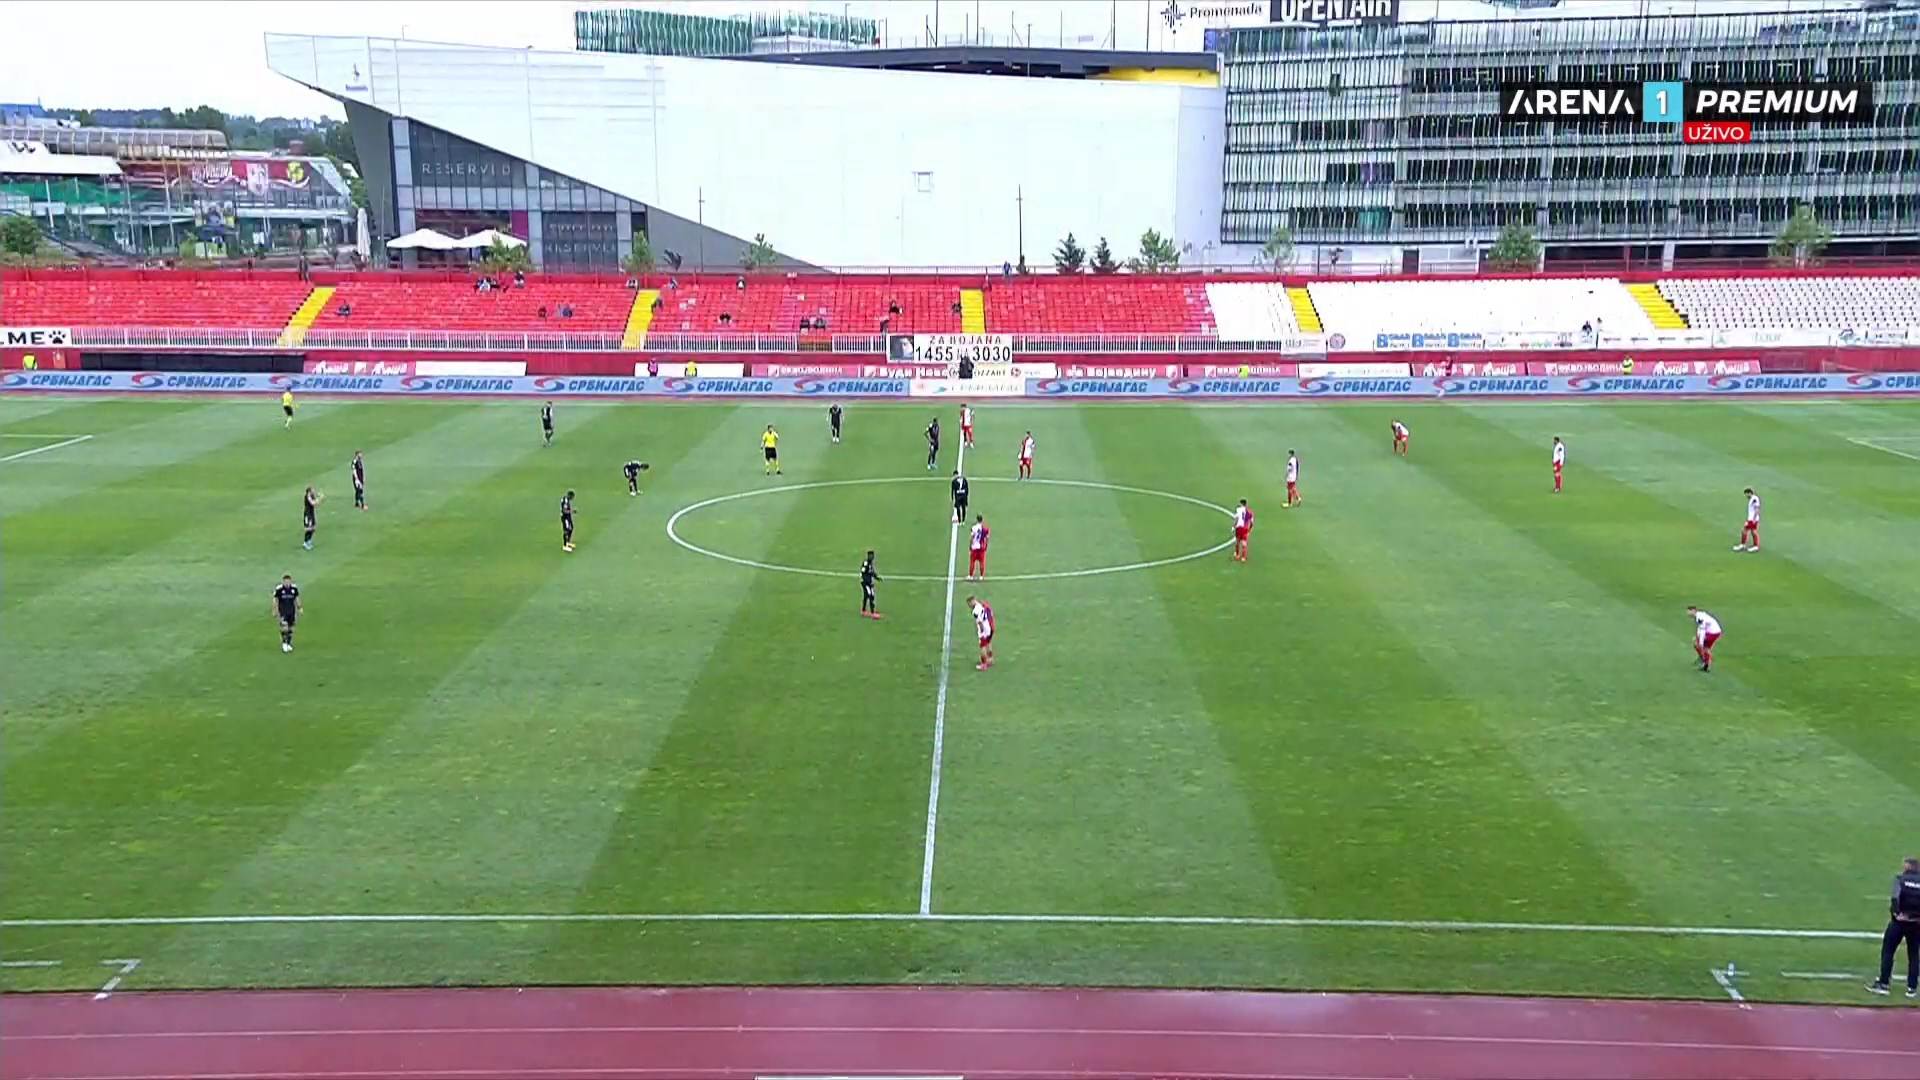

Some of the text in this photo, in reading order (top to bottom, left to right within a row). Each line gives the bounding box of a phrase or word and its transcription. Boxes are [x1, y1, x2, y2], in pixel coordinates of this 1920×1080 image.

[1190, 3, 1262, 18] Promenada
[1280, 0, 1344, 21] OPEN
[0, 331, 46, 345] ME
[915, 345, 953, 362] 1455
[972, 345, 1011, 362] 3030
[31, 374, 113, 387] СРБИЈАГАС
[167, 375, 247, 388] СРБИЈАГАС
[306, 377, 383, 389] СРБИЈАГАС
[435, 379, 514, 391] СРБИЈАГАС
[568, 380, 645, 392] СРБИЈАГАС
[697, 380, 773, 392] СРБИЈАГАС
[1333, 380, 1412, 392] СРБИЈАГАС
[1468, 379, 1549, 391] СРБИЈАГАС
[1603, 379, 1685, 390] СРБИЈАГАС
[1745, 377, 1828, 389] СРБИЈАГАС
[828, 381, 904, 393] СРБИЈАГАС
[1071, 381, 1149, 393] СРБИЈАГАС
[1203, 381, 1281, 393] СРБИЈАГАС
